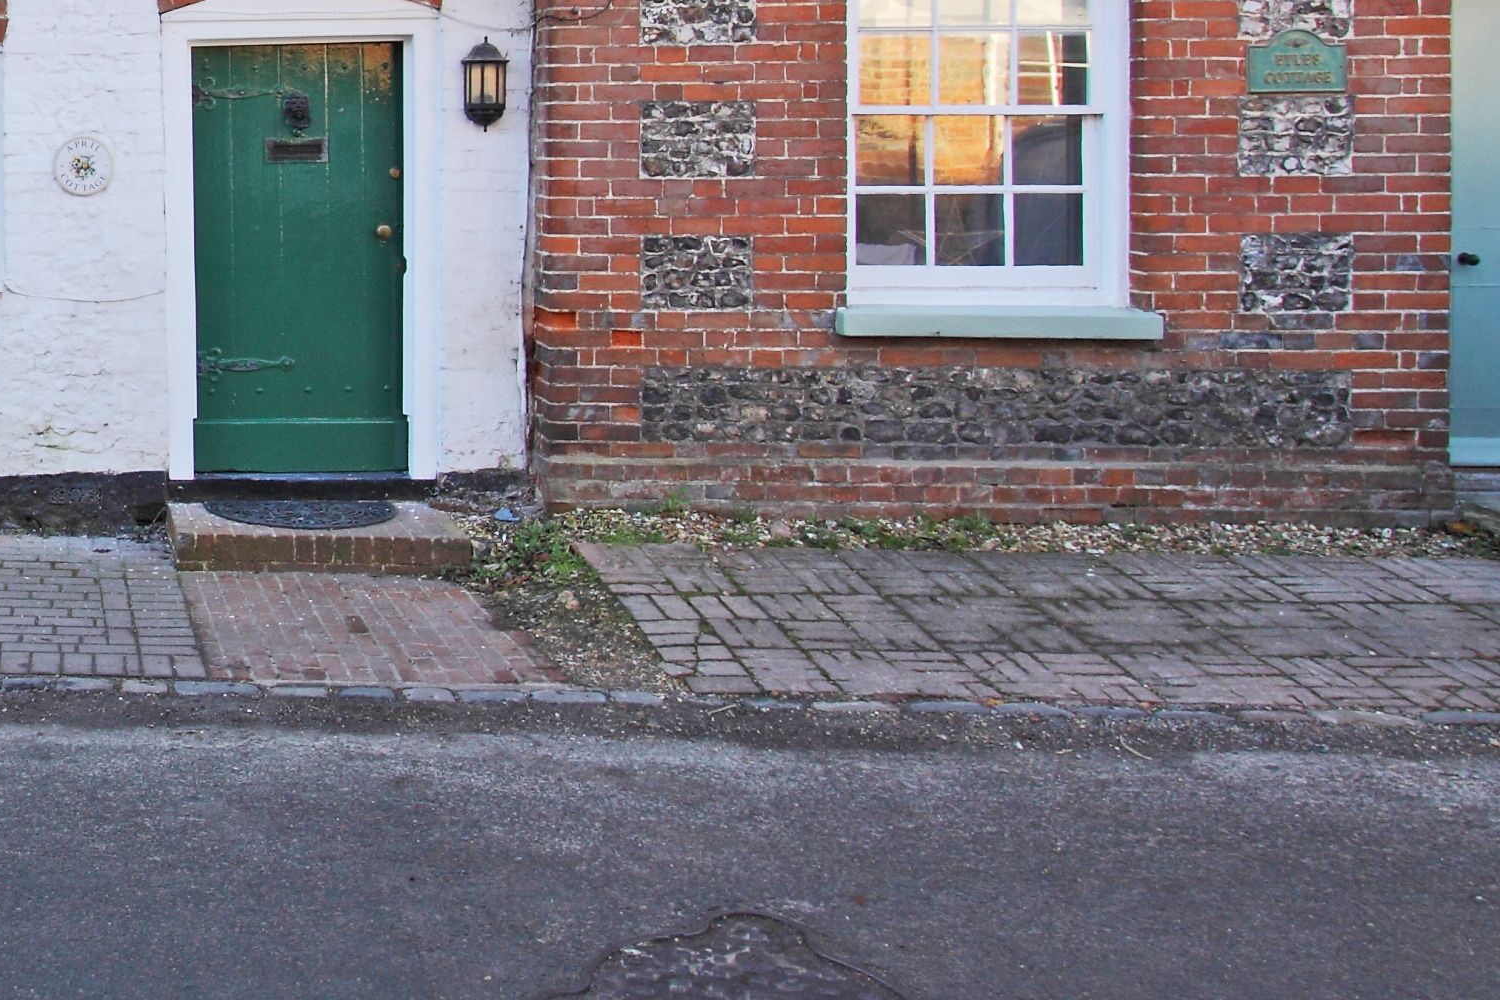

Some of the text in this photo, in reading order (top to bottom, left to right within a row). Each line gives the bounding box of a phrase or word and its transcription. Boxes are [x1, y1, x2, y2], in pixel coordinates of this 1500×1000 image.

[1263, 71, 1332, 84] COTTAGE
[67, 140, 100, 152] APRIL
[60, 173, 106, 191] COTTAGE
